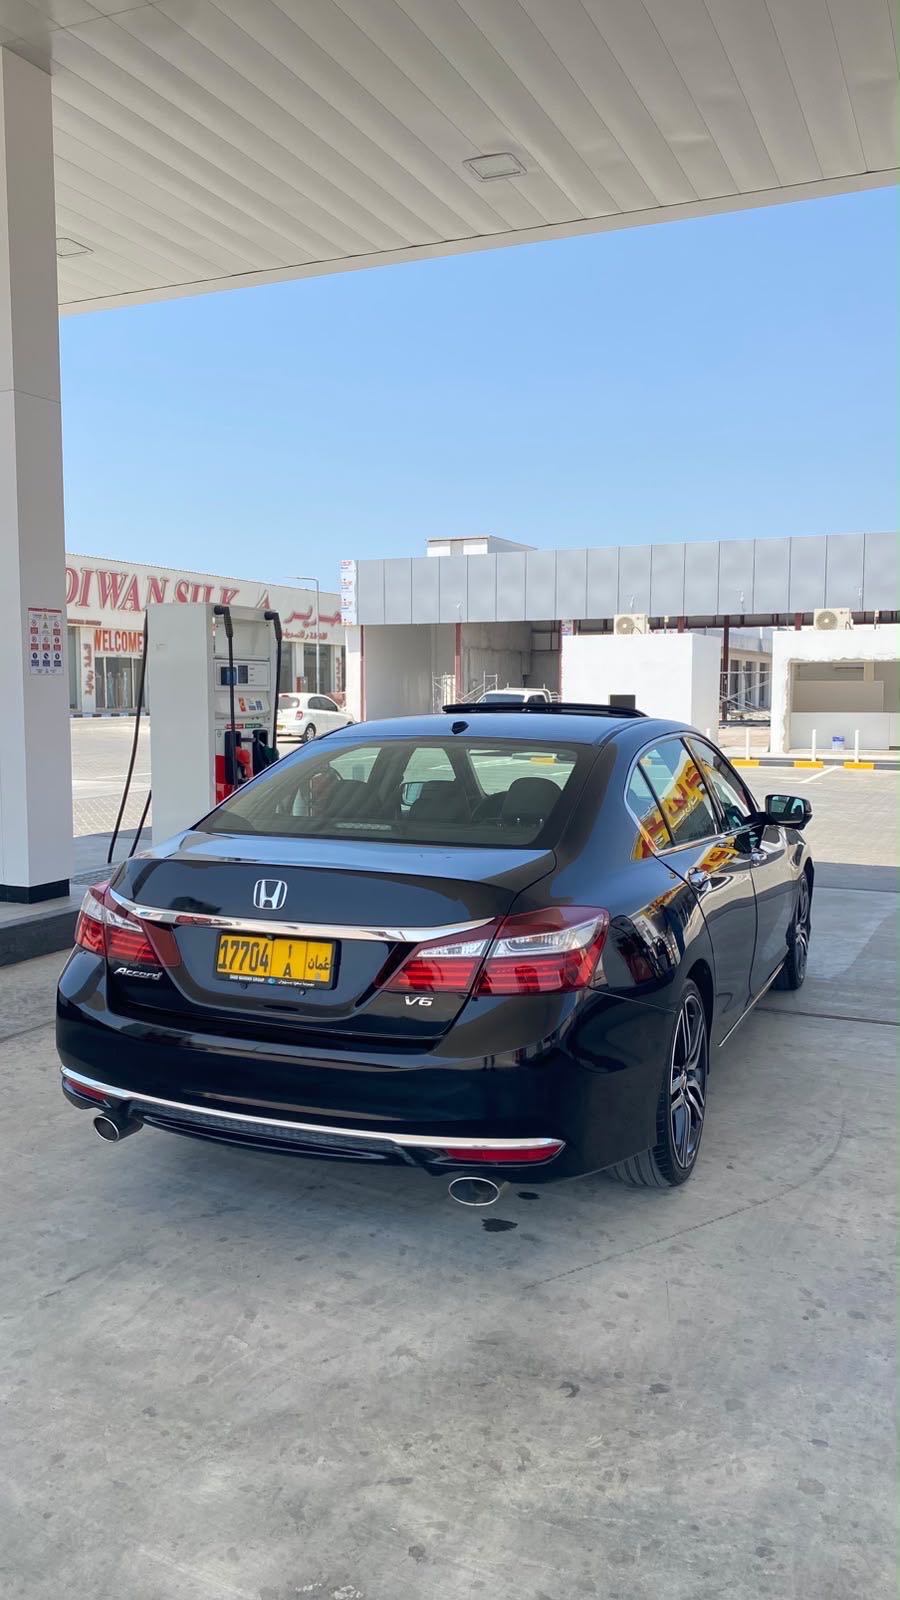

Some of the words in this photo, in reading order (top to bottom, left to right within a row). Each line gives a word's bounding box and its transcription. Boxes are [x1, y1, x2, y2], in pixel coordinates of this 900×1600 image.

[218, 939, 269, 973] 17704
[113, 967, 163, 981] Accord
[282, 962, 292, 978] A
[404, 995, 434, 1007] V6
